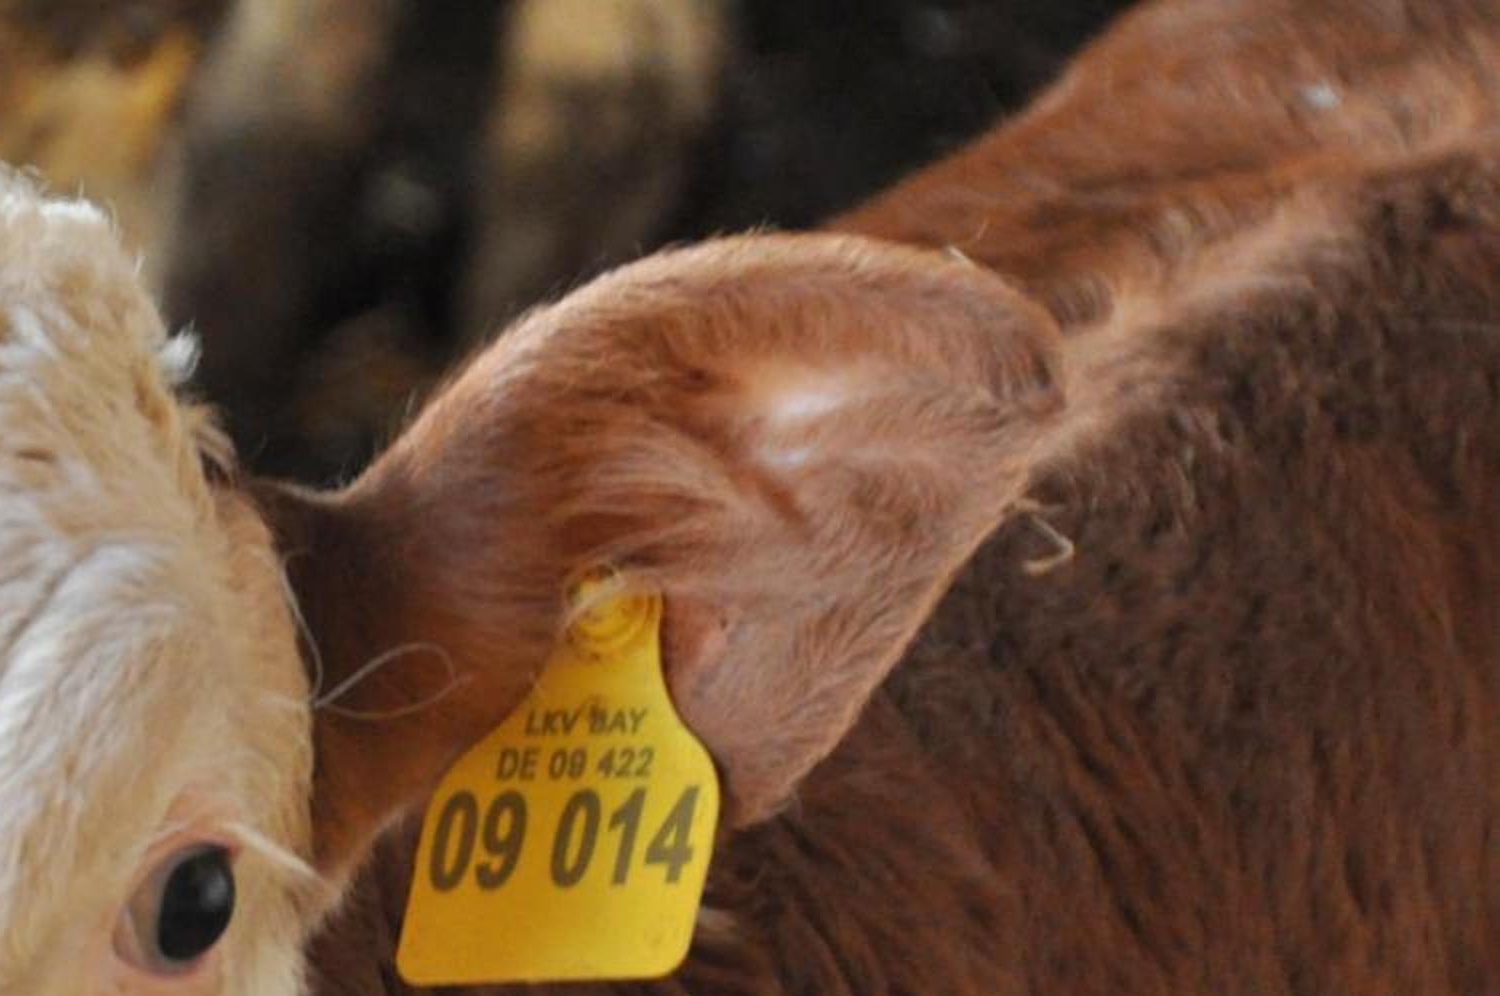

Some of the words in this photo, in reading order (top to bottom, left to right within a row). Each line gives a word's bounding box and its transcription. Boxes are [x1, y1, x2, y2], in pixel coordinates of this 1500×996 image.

[525, 708, 579, 736] LKV
[588, 707, 648, 735] BAY
[496, 749, 542, 781] DE
[548, 749, 587, 781] 09
[597, 748, 655, 779] 422
[429, 789, 527, 893] 09
[551, 785, 700, 889] 014
